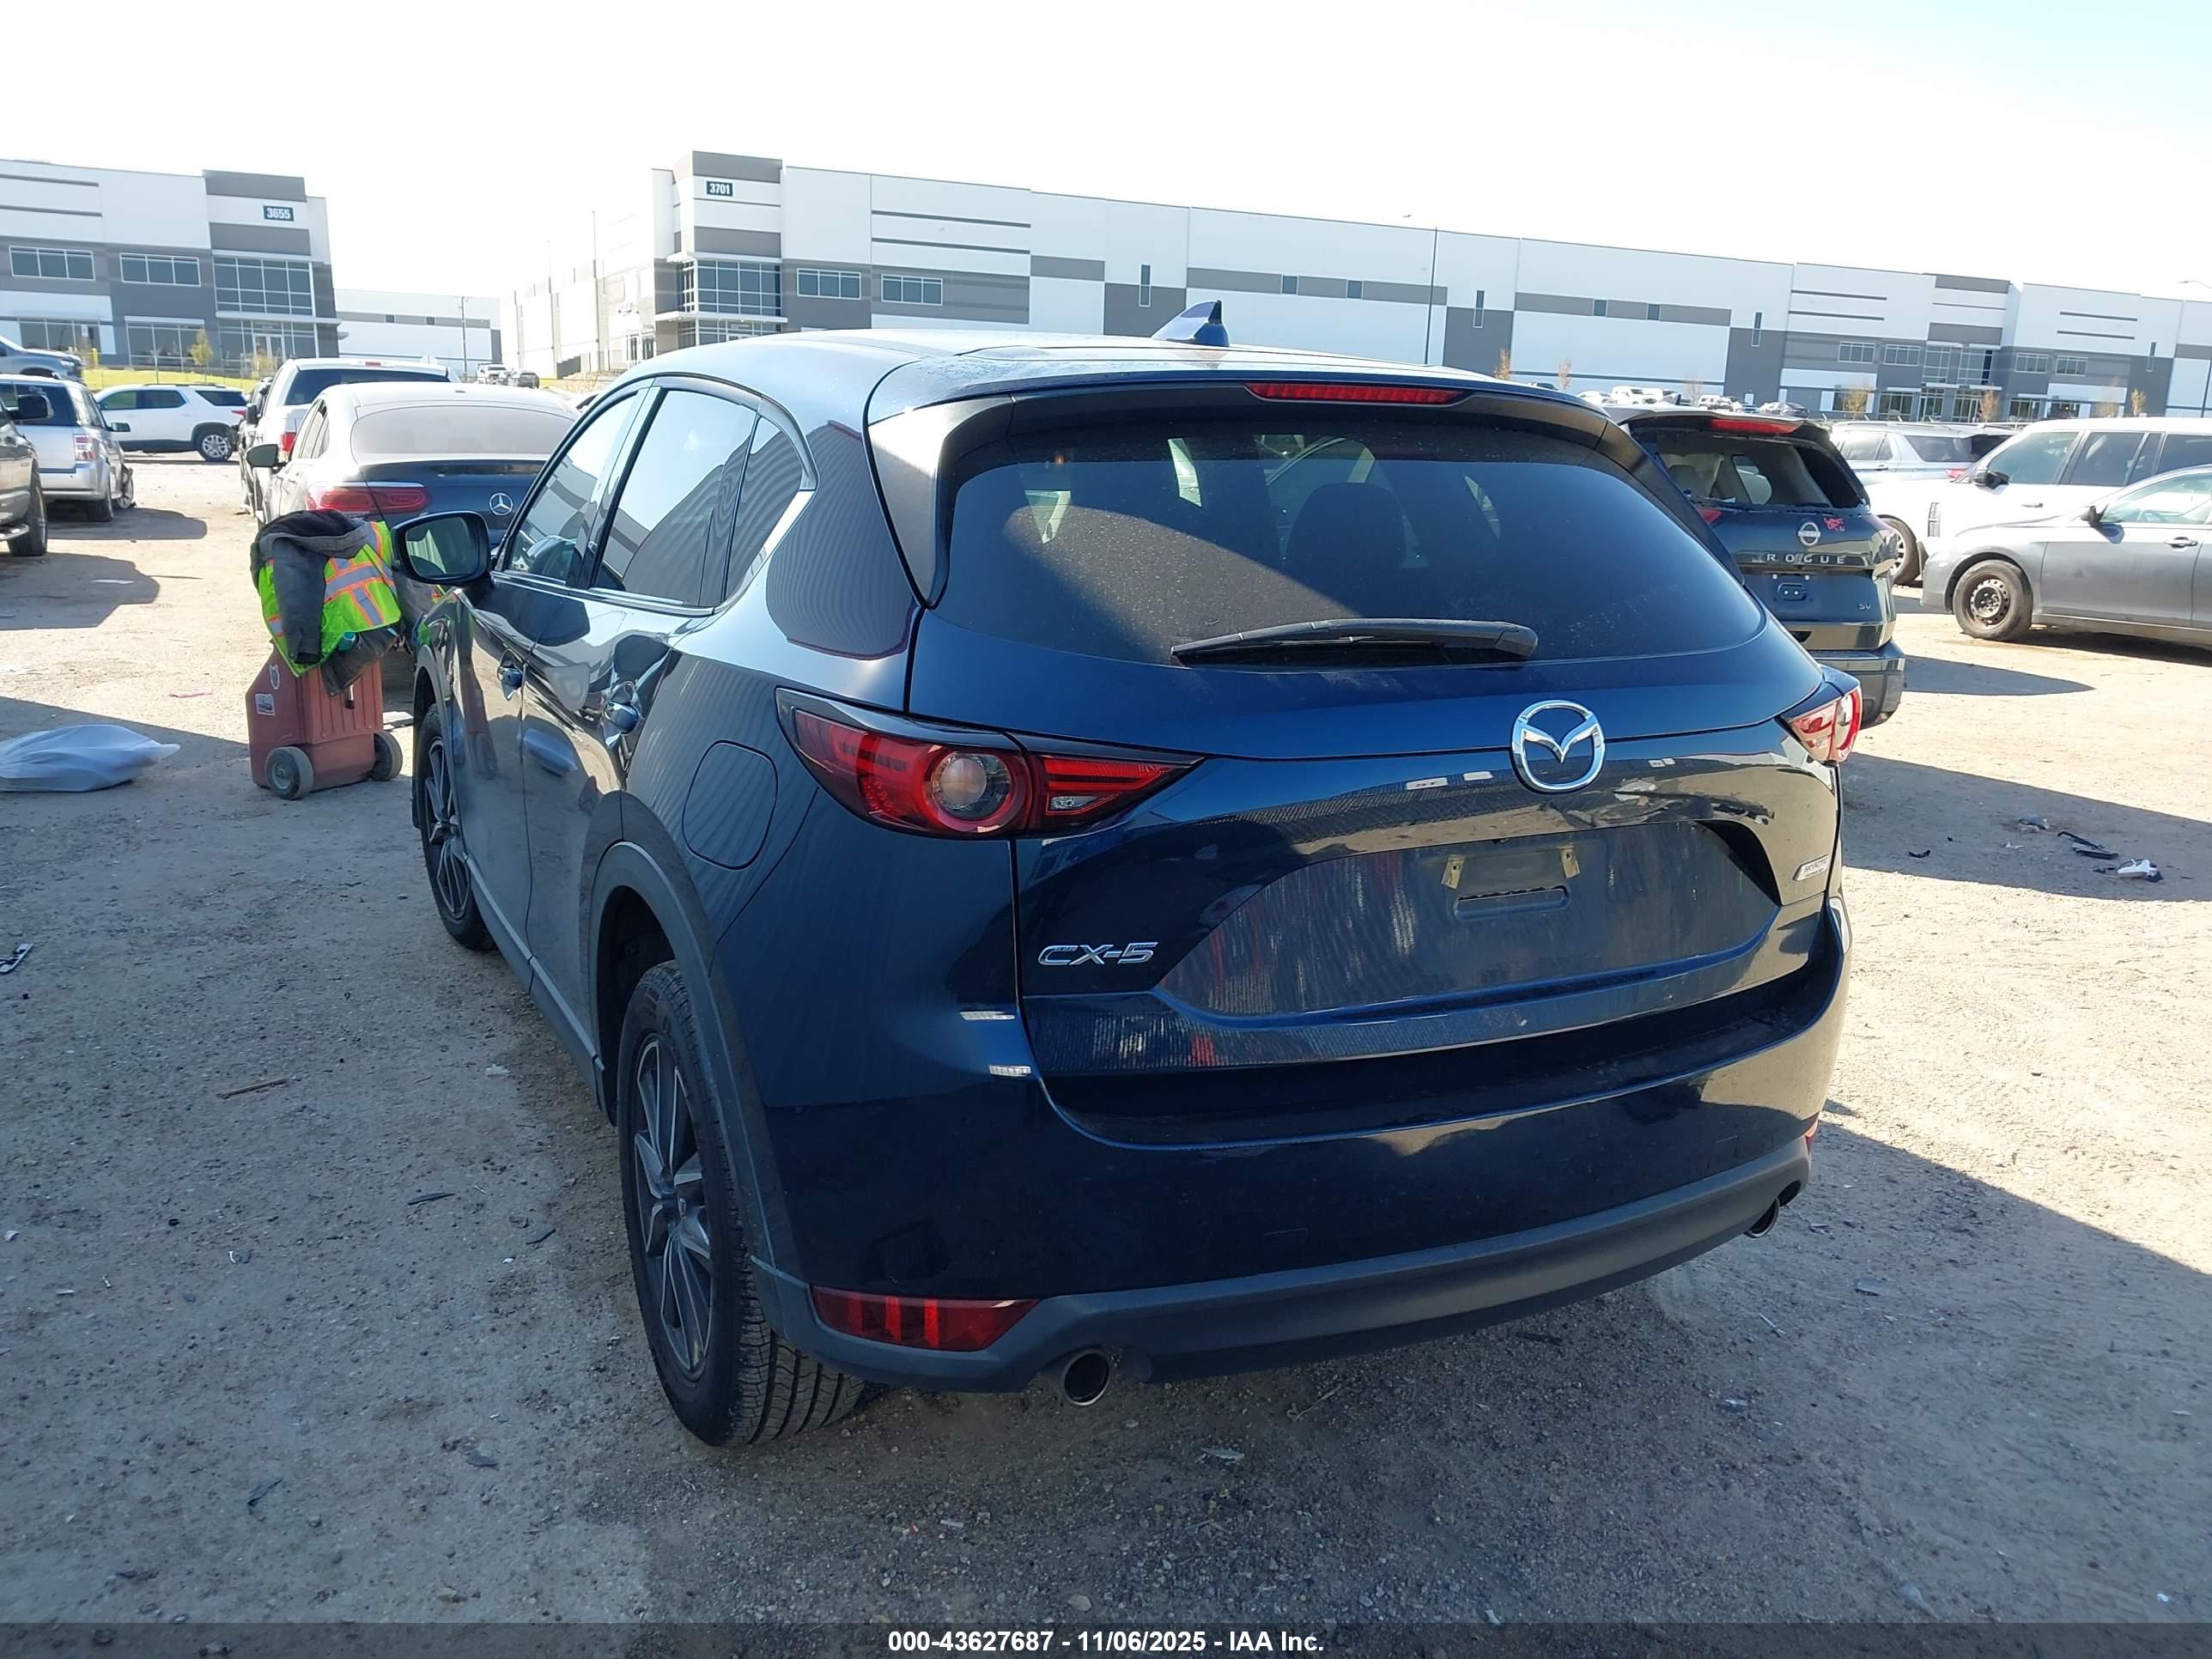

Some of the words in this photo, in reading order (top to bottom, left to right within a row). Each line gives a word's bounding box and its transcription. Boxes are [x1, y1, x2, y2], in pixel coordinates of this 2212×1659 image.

[709, 183, 730, 194] 3701
[266, 207, 290, 219] 3655
[1766, 553, 1845, 564] ROGUE
[1037, 941, 1159, 966] CX-5
